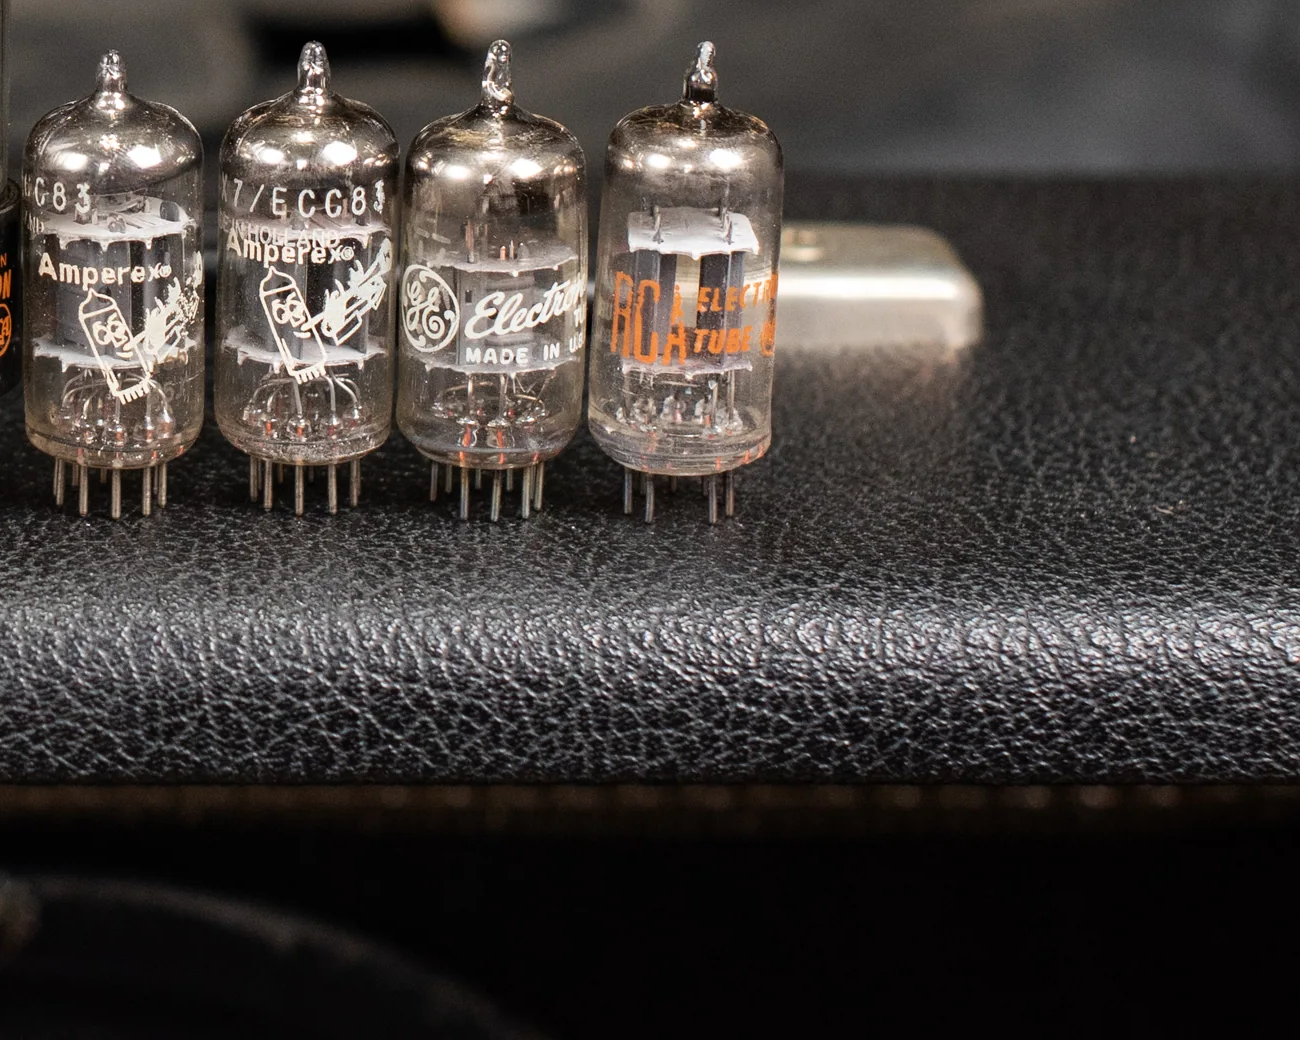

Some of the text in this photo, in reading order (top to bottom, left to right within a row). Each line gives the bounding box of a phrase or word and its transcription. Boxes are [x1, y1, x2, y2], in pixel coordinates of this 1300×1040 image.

[609, 271, 688, 365] RCA
[465, 347, 529, 364] MADE
[543, 342, 560, 361] IN
[693, 325, 753, 355] TUBE
